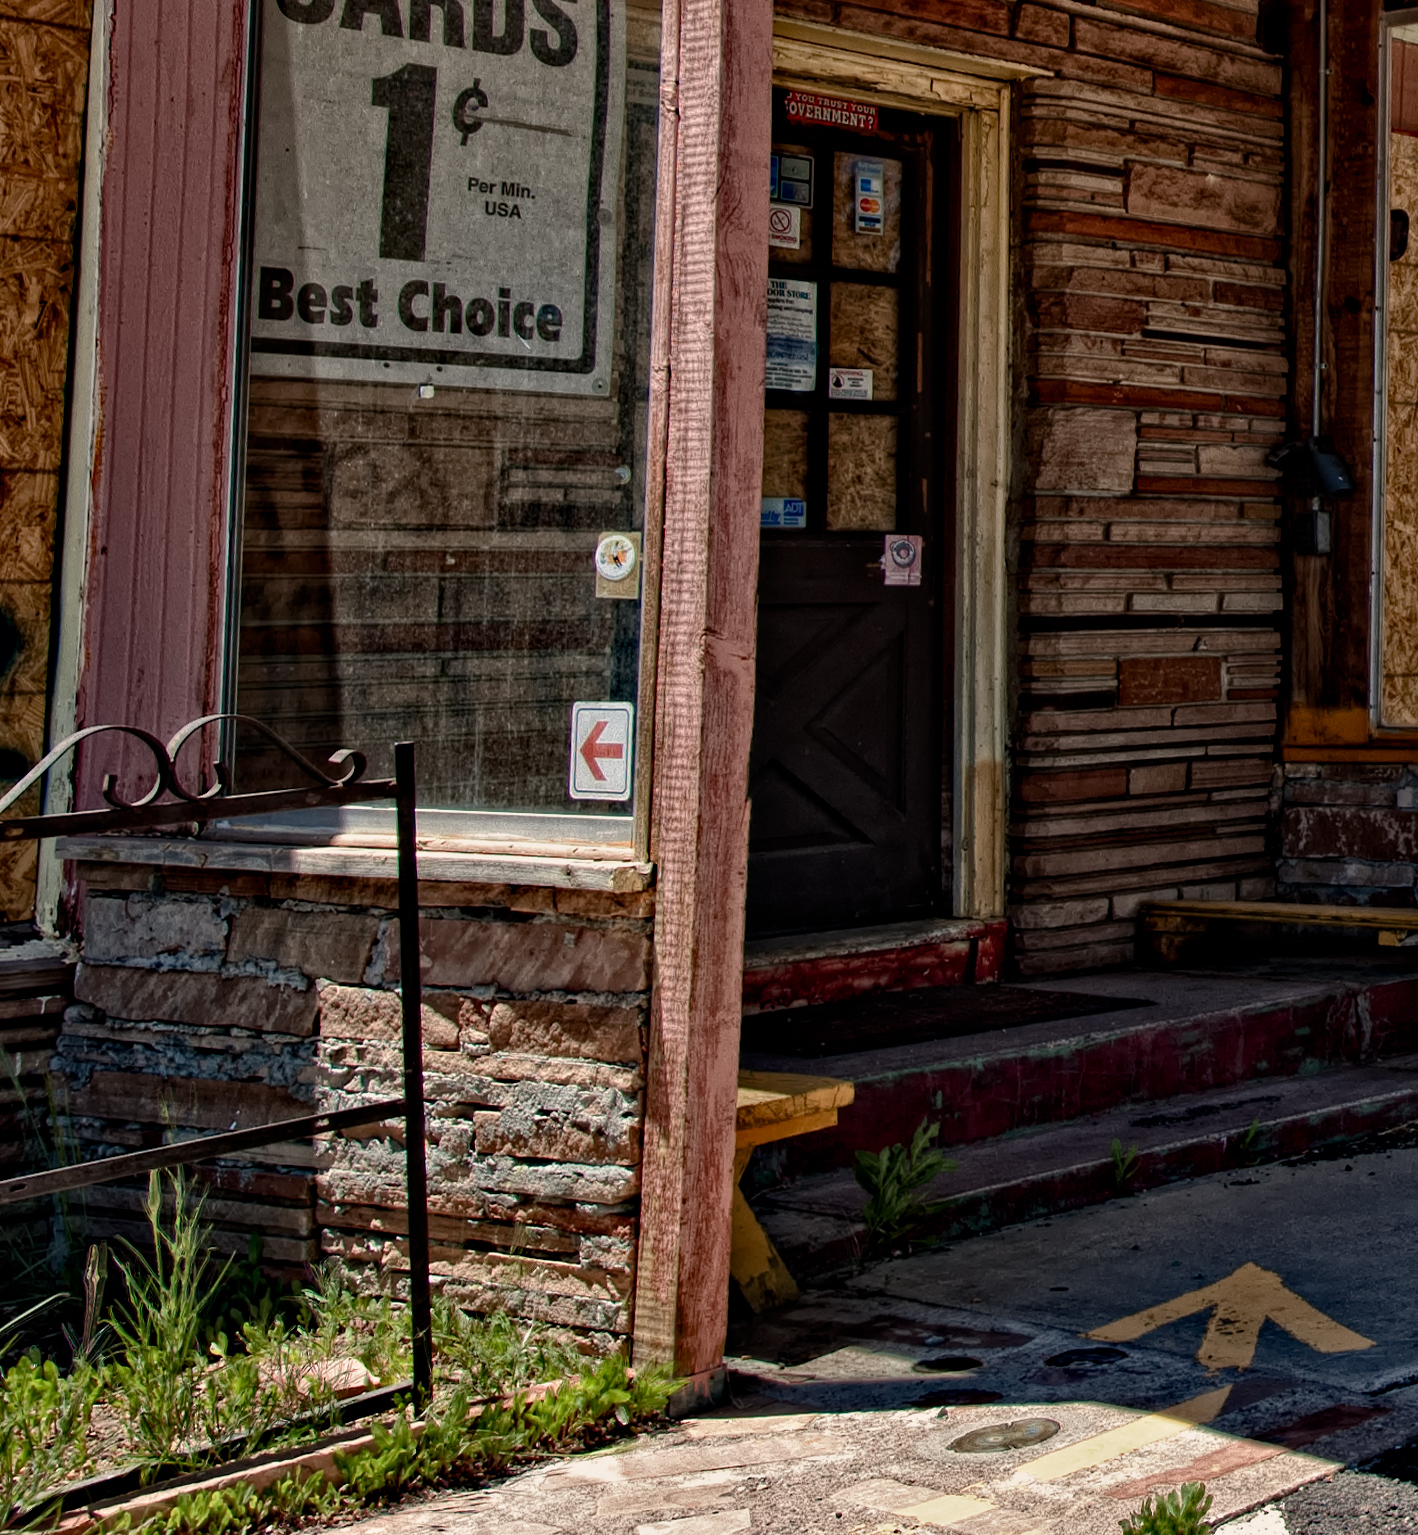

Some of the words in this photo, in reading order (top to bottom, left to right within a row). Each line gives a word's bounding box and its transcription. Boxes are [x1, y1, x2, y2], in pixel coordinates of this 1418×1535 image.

[817, 97, 848, 110] TRUST
[850, 102, 876, 116] YOUR
[466, 177, 497, 199] Per
[500, 180, 537, 201] Min.
[484, 201, 523, 220] USA
[257, 265, 380, 329] Best
[397, 278, 565, 343] Choice
[783, 501, 805, 516] ADT
